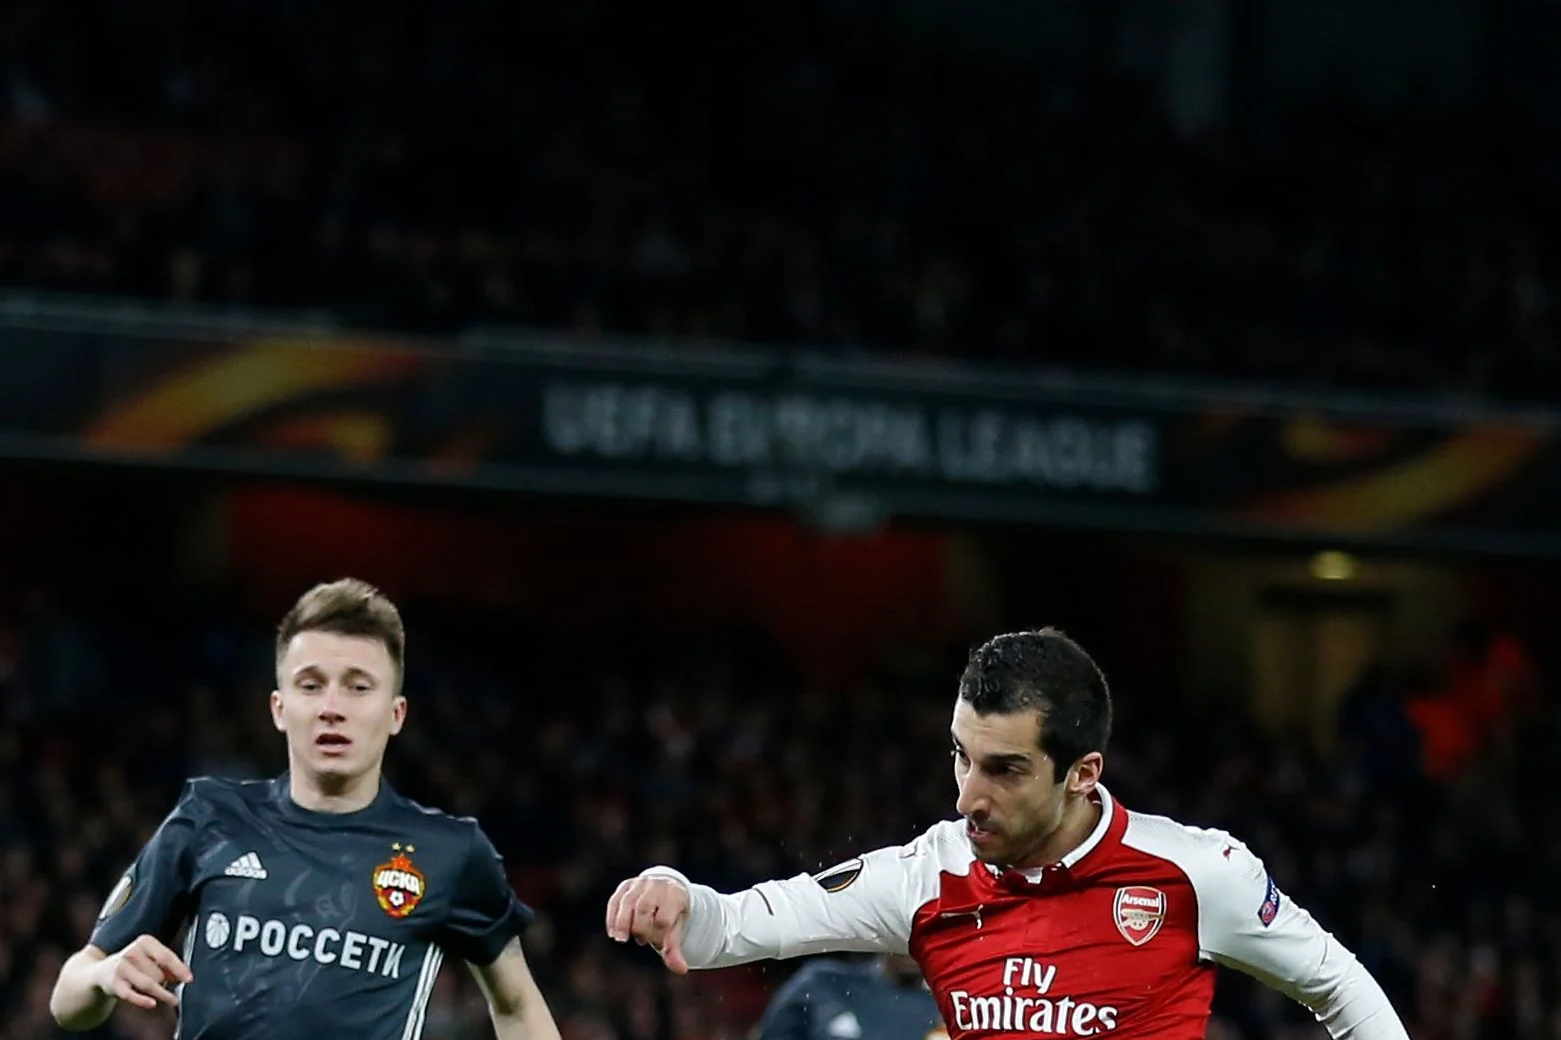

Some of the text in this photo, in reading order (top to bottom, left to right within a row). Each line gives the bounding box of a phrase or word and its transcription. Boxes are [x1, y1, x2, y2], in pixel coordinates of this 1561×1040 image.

[544, 385, 699, 457] UEFA
[938, 411, 1155, 491] LEAGUE
[1121, 893, 1159, 908] Arsenal
[1002, 957, 1057, 994] Fly
[950, 986, 1118, 1036] Emirates
